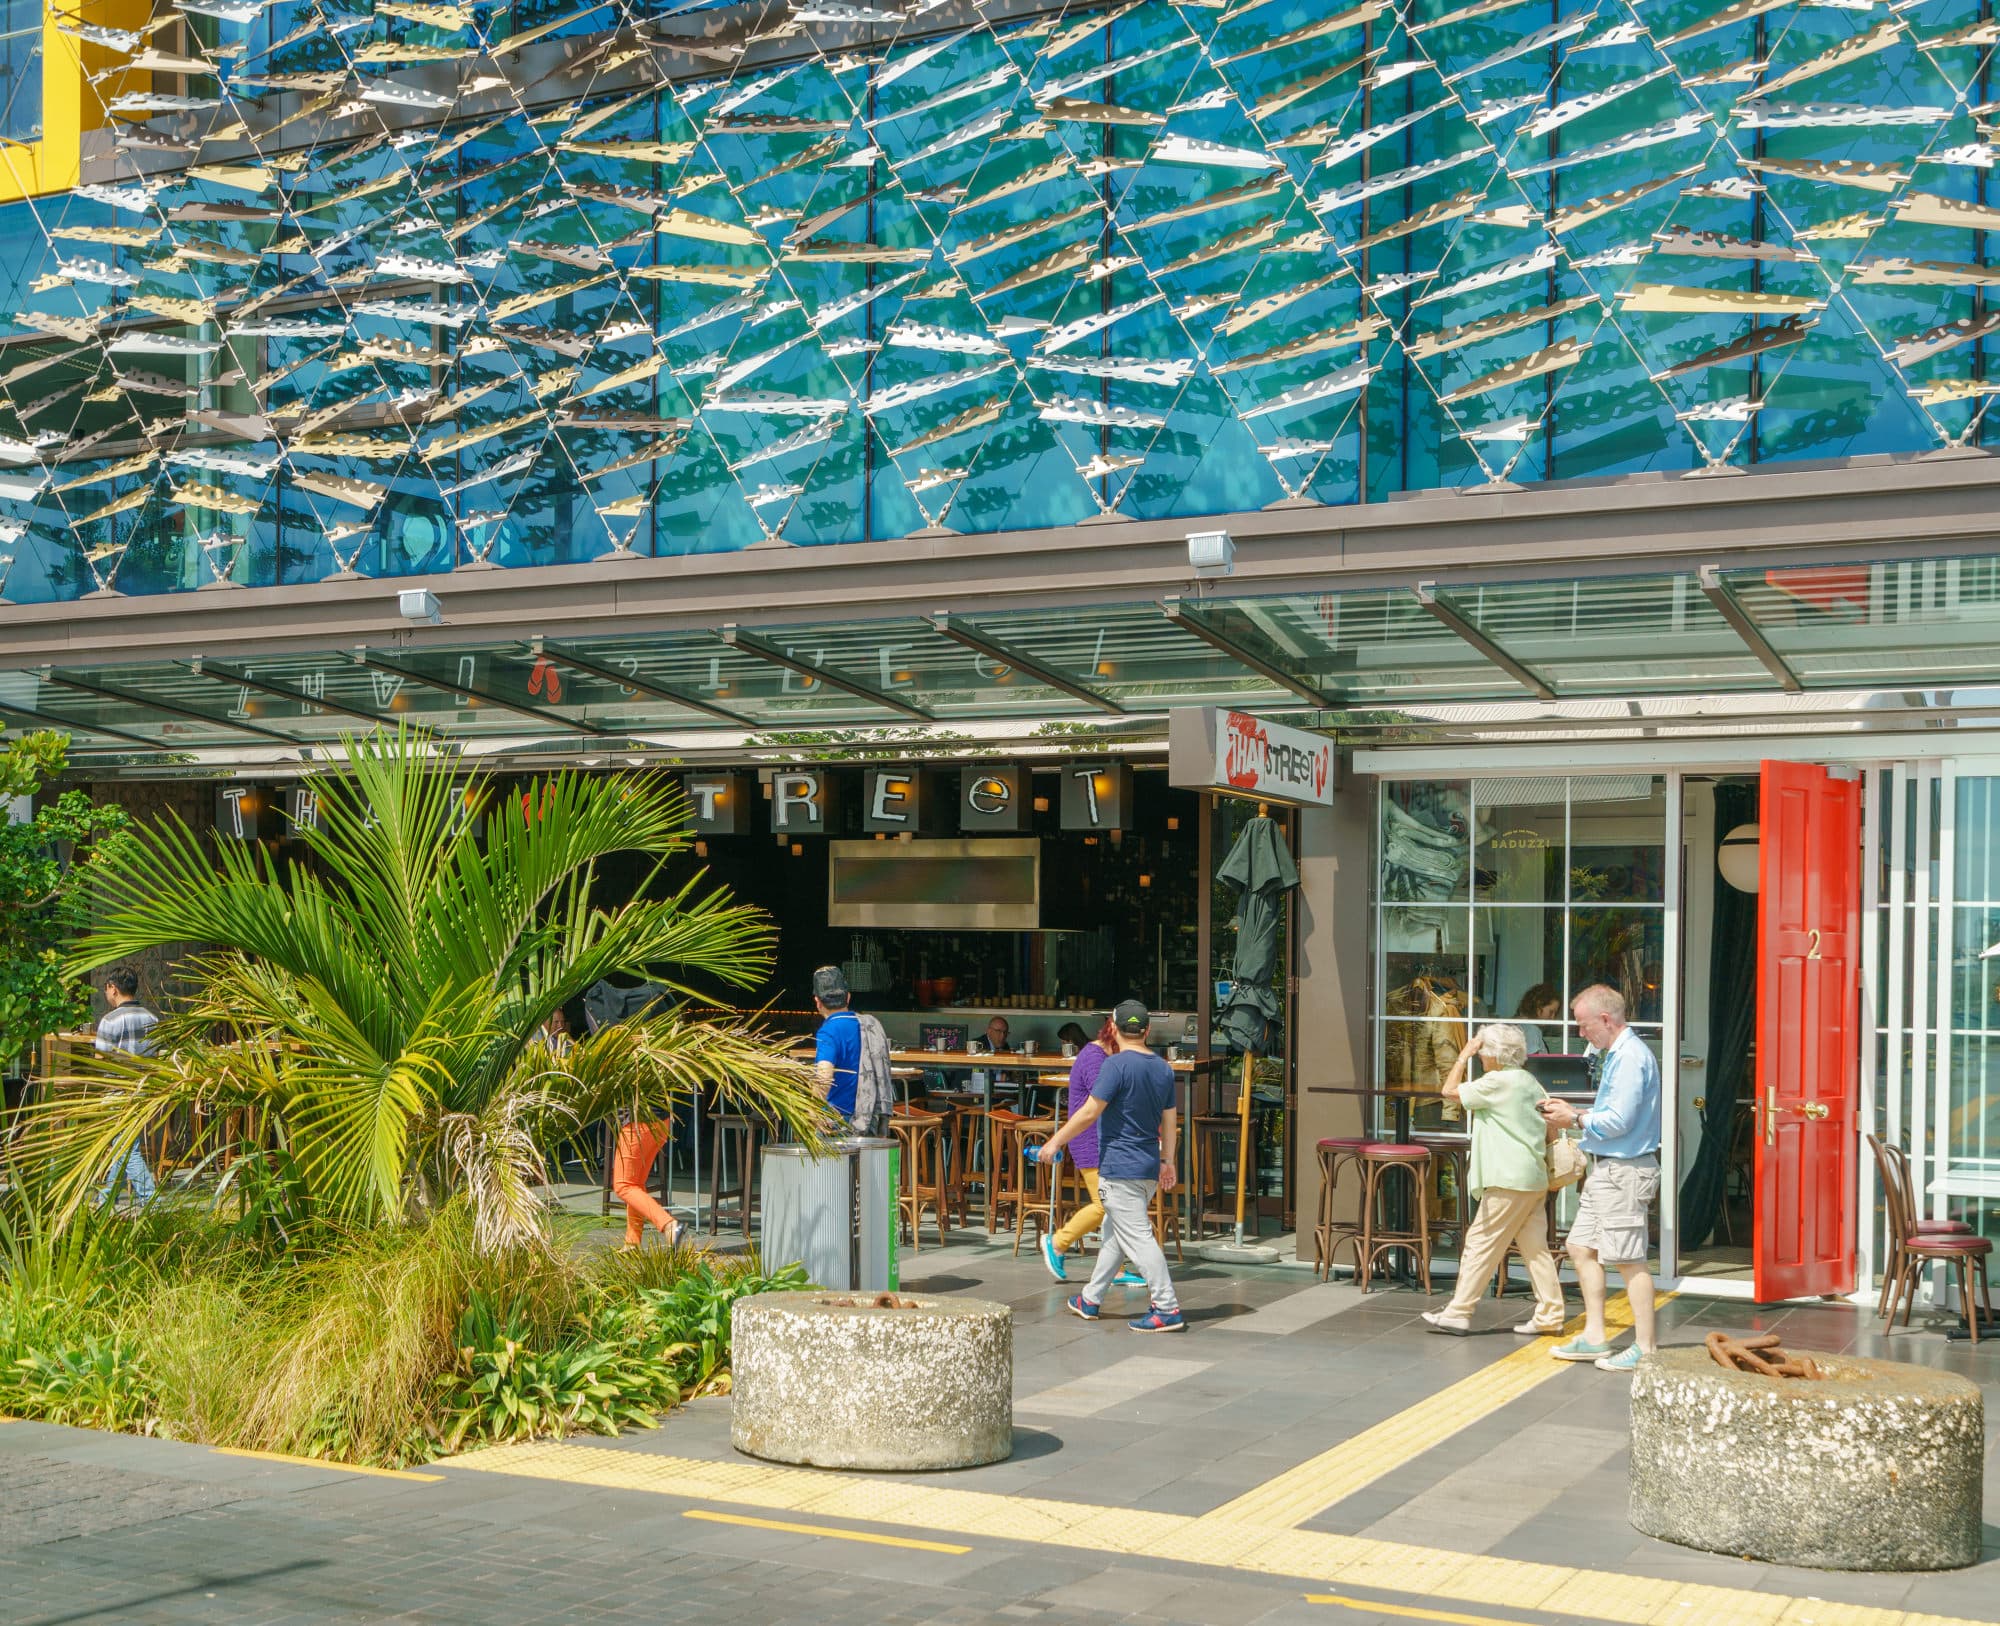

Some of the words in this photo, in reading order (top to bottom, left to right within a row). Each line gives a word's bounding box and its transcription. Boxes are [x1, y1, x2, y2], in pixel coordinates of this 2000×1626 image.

[1227, 727, 1266, 785] THAI
[223, 787, 473, 838] THI
[611, 769, 1104, 827] TREeT
[1491, 839, 1550, 849] BADUZZI
[1808, 928, 1821, 960] 2
[853, 1179, 861, 1238] Litter
